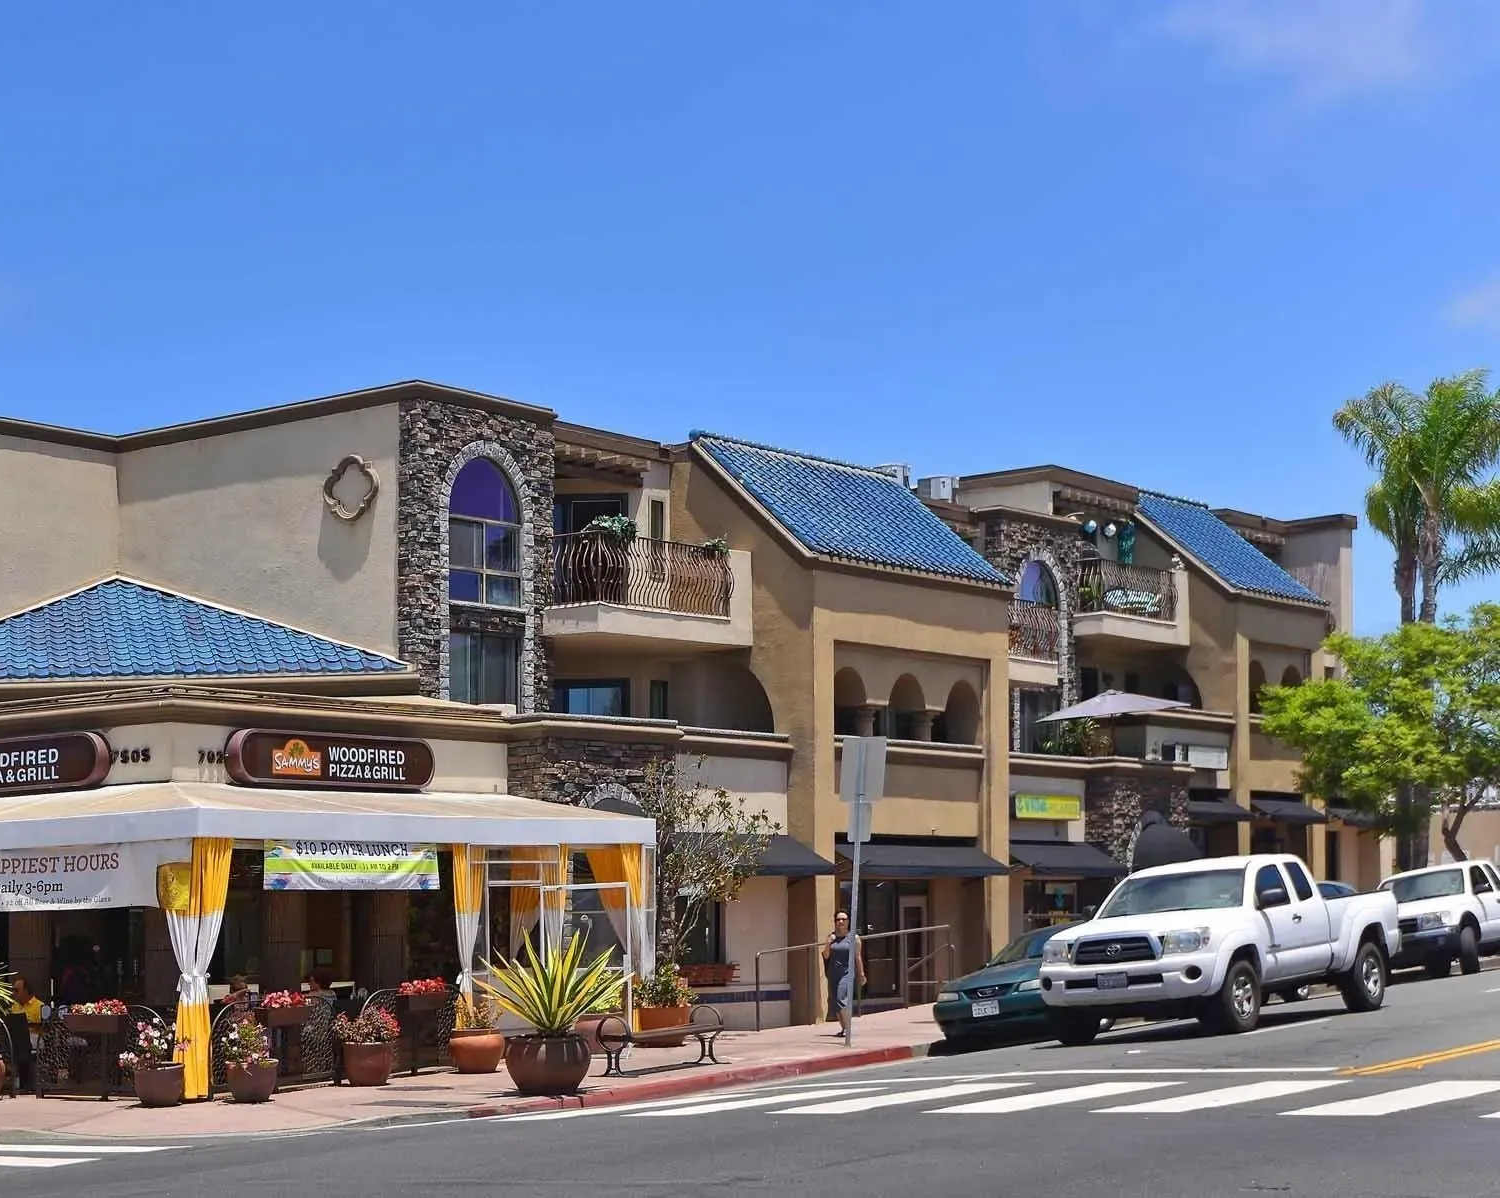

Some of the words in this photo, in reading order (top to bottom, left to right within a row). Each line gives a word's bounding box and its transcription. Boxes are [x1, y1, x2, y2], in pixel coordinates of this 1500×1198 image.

[328, 746, 405, 765] WOODFIRED
[295, 841, 317, 856] $10
[321, 842, 364, 856] POWER
[366, 843, 409, 857] LUNCH
[63, 853, 119, 872] HOURS
[25, 880, 63, 895] 3-6pm
